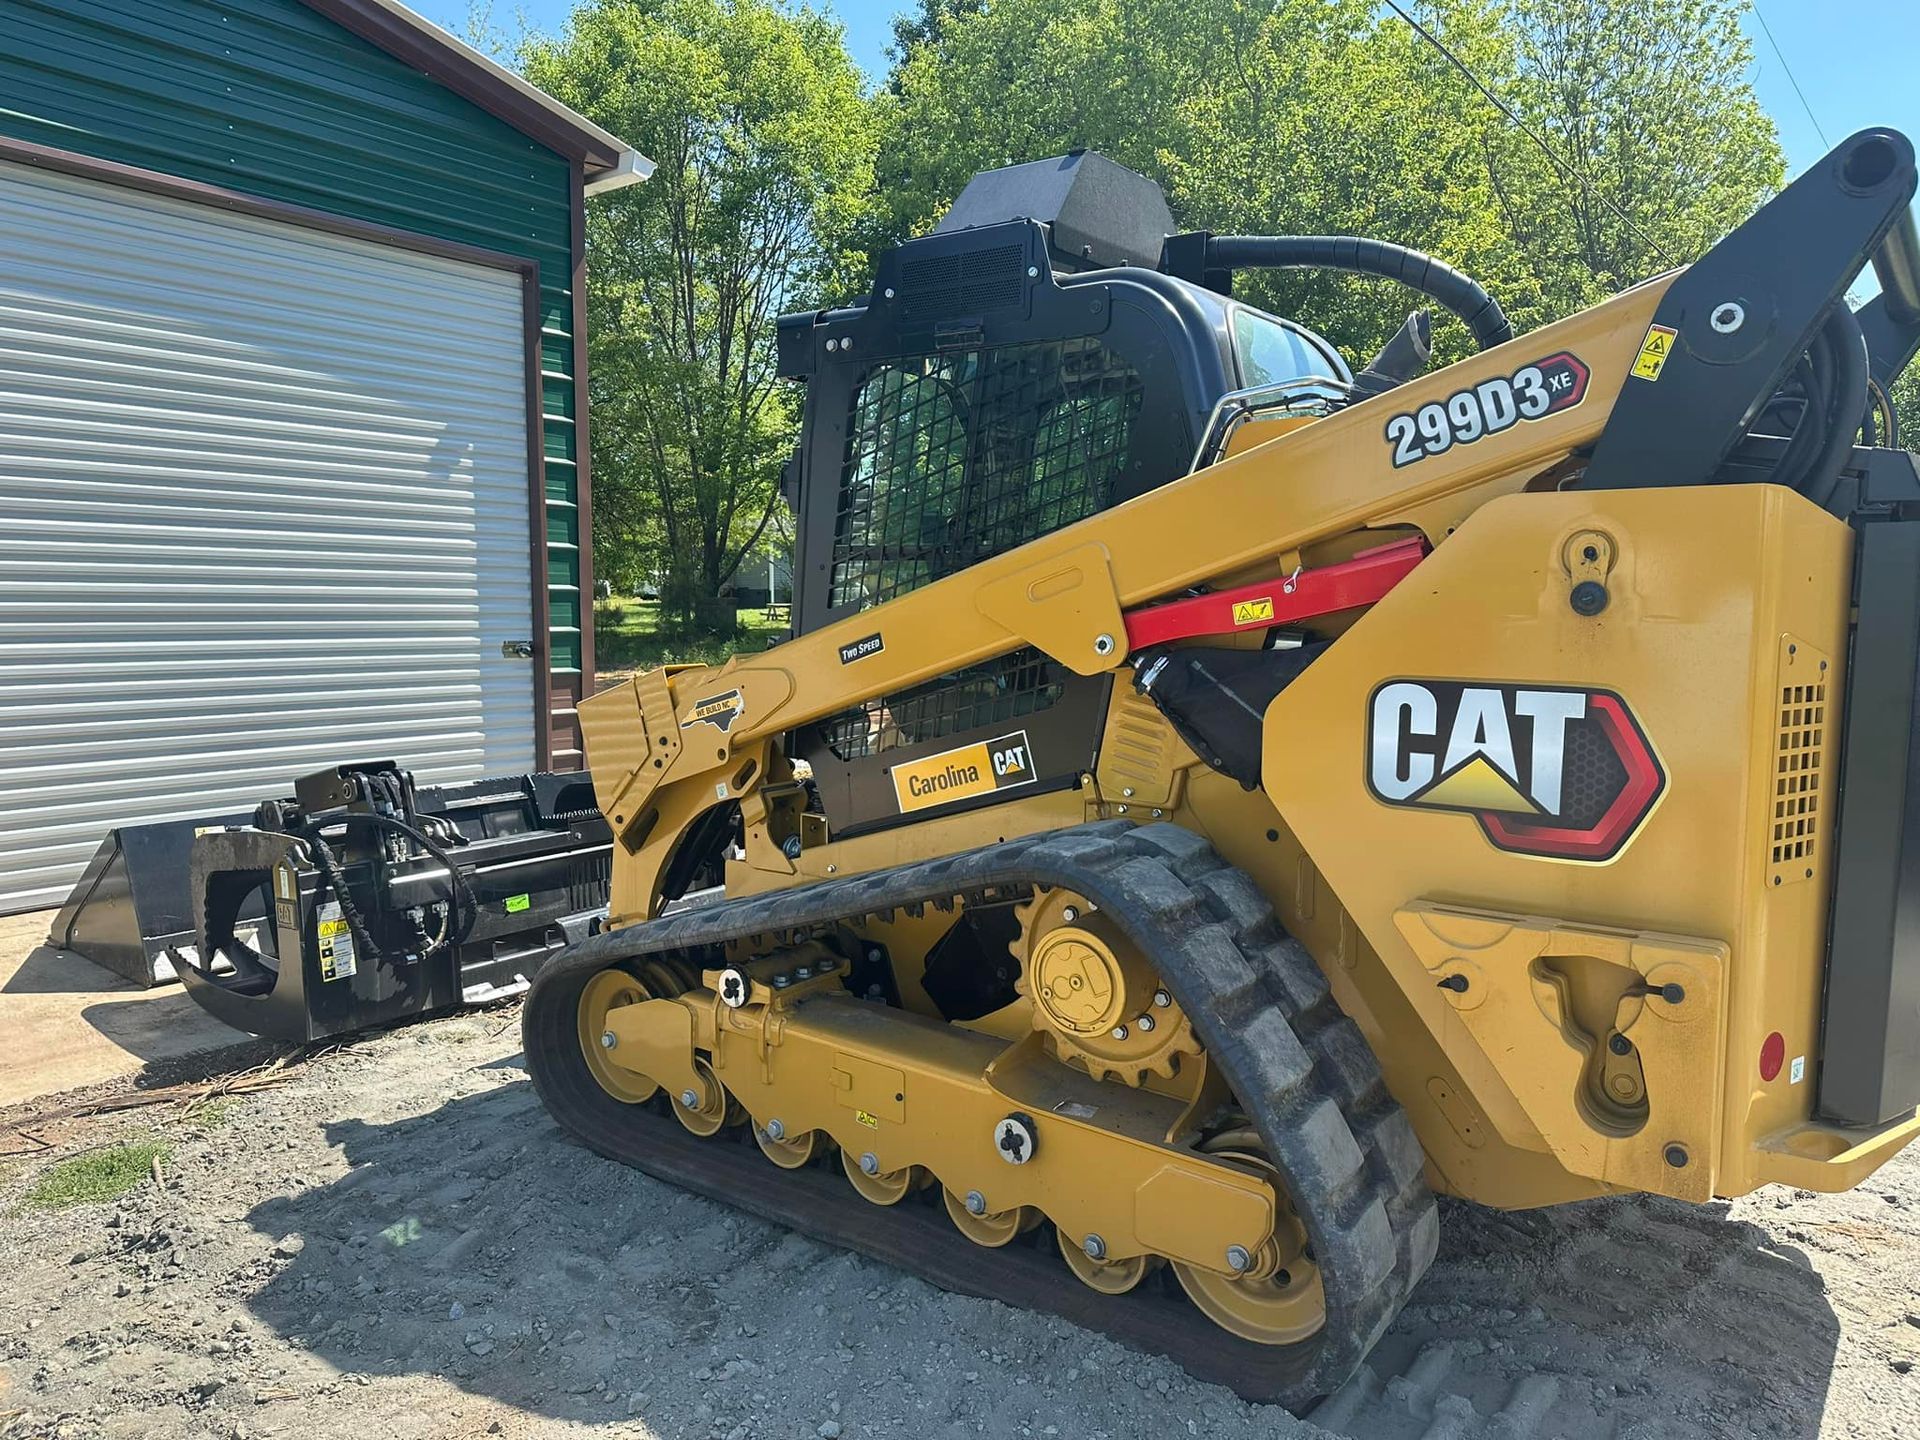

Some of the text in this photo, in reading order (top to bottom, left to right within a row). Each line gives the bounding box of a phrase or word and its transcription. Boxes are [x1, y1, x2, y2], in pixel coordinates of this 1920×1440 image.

[1388, 367, 1572, 466] 299D3 XE
[696, 700, 731, 718] WE BUILD NC
[909, 746, 1025, 796] Carolina CAT
[1372, 683, 1587, 816] CAT
